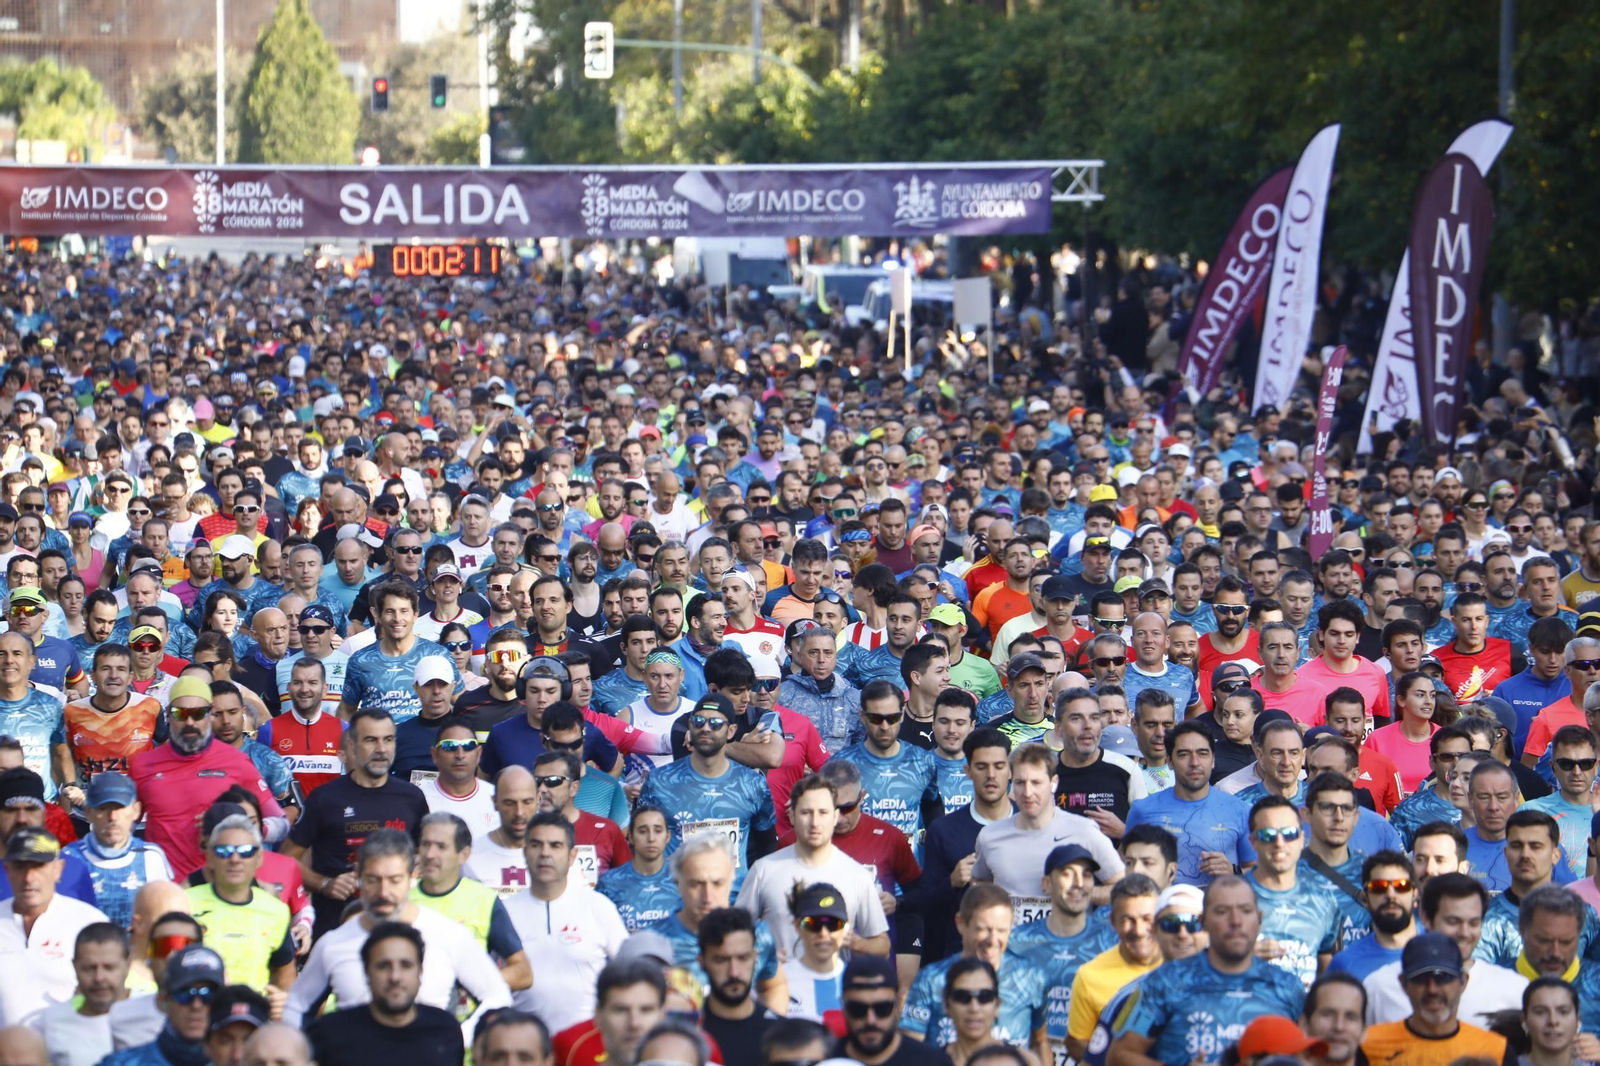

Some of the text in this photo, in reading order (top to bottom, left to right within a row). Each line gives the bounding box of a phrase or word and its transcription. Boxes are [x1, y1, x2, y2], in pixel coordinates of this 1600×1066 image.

[55, 186, 168, 211] IMDECO
[222, 181, 273, 198] MEDIA
[609, 184, 659, 200] MEDIA
[941, 181, 1043, 200] AYUNTAMIENTO
[192, 193, 222, 215] 38
[222, 192, 304, 214] MARATÓN
[338, 183, 530, 225] SALIDA
[581, 196, 609, 218] 38
[609, 195, 689, 216] MARATÓN
[758, 189, 866, 212] IMDECO
[941, 200, 959, 218] DE
[21, 211, 167, 222] Instituto Municipal de Deportes Córdoba
[222, 213, 304, 229] CÓRDOBA 2024
[661, 219, 688, 230] 2024
[1192, 203, 1281, 360] IMDECO
[380, 690, 412, 700] MEDIA
[296, 760, 333, 769] Avanza
[872, 798, 907, 810] MEDIA
[636, 910, 669, 921] MEDIA
